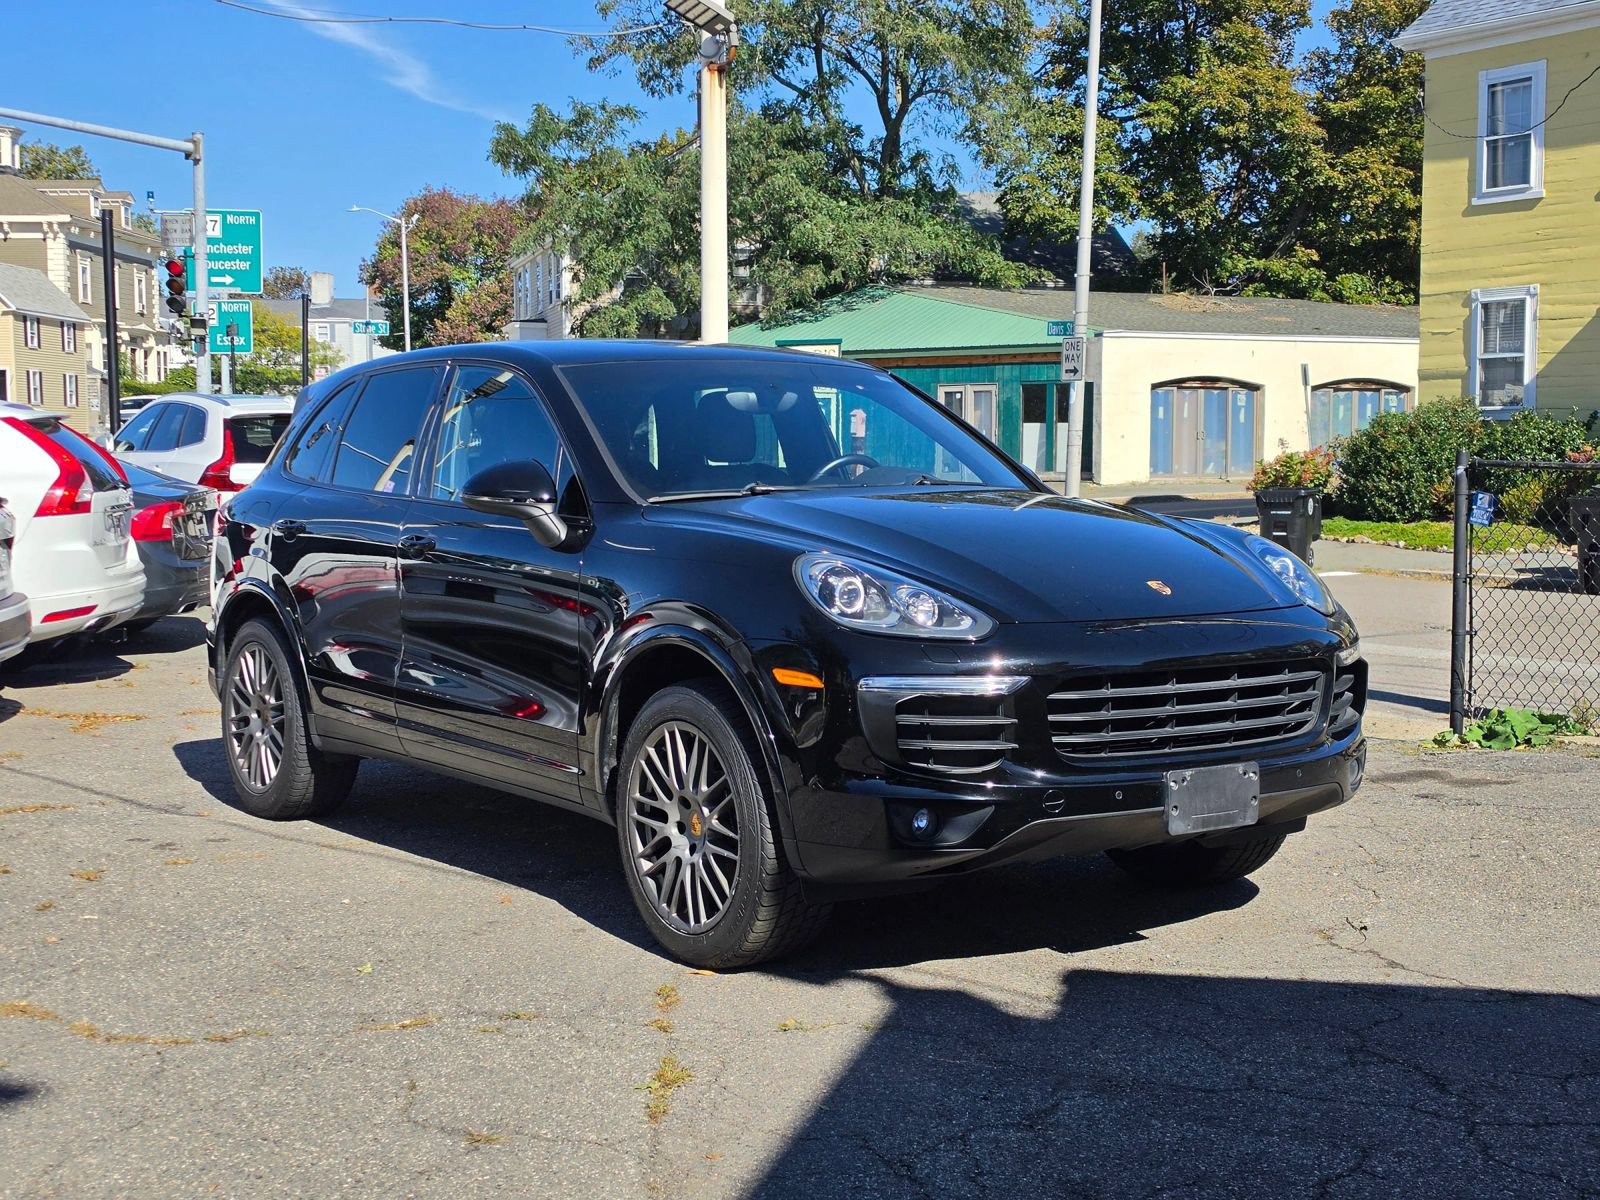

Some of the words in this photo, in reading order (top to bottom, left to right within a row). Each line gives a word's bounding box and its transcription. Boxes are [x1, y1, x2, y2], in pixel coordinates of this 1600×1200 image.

[206, 219, 218, 232] 7
[226, 214, 256, 225] NORTH
[192, 242, 254, 255] nchester
[207, 258, 251, 270] oucester
[208, 308, 216, 320] 2
[221, 302, 249, 313] NORTH
[378, 323, 386, 334] St
[1048, 322, 1064, 335] Davis
[1065, 341, 1081, 351] ONE
[1065, 353, 1081, 363] WAY
